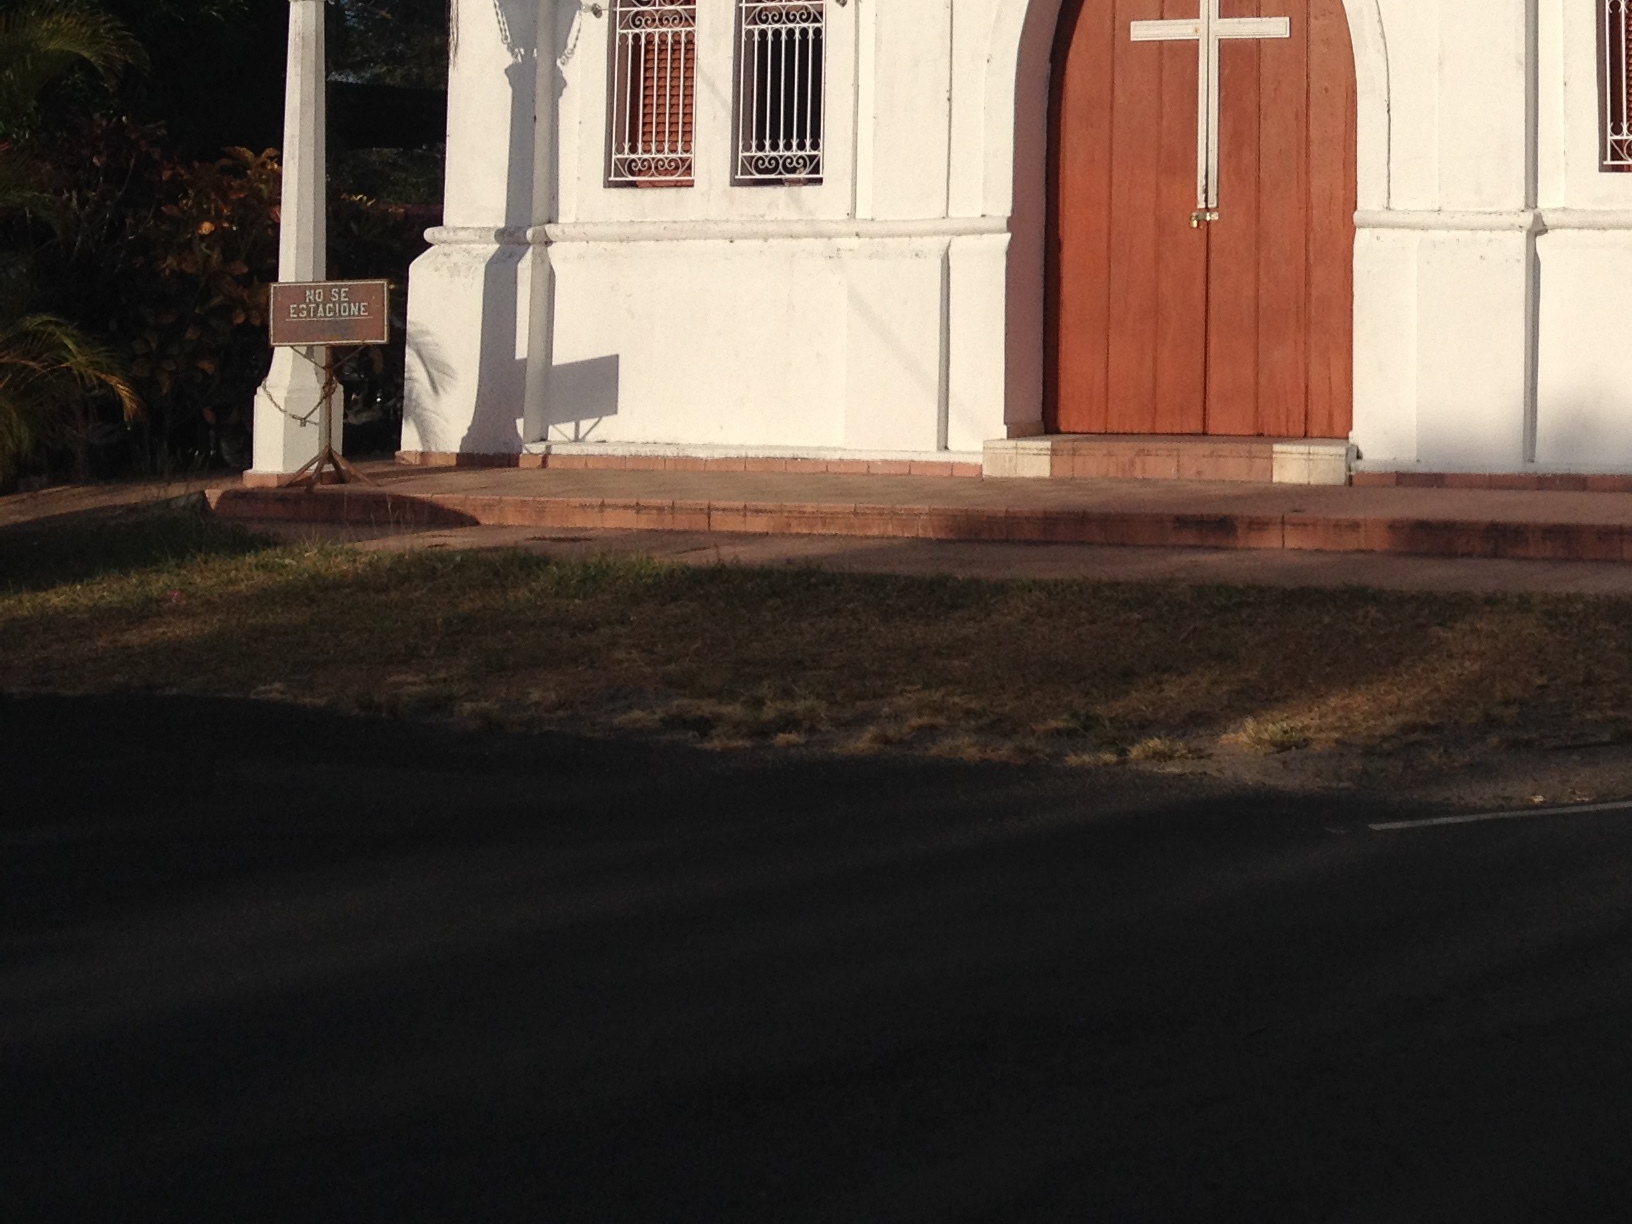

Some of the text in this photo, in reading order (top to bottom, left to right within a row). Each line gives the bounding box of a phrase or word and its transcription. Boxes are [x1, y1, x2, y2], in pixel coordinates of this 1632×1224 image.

[305, 288, 349, 303] NO SE
[289, 302, 369, 317] ESTACIONE
